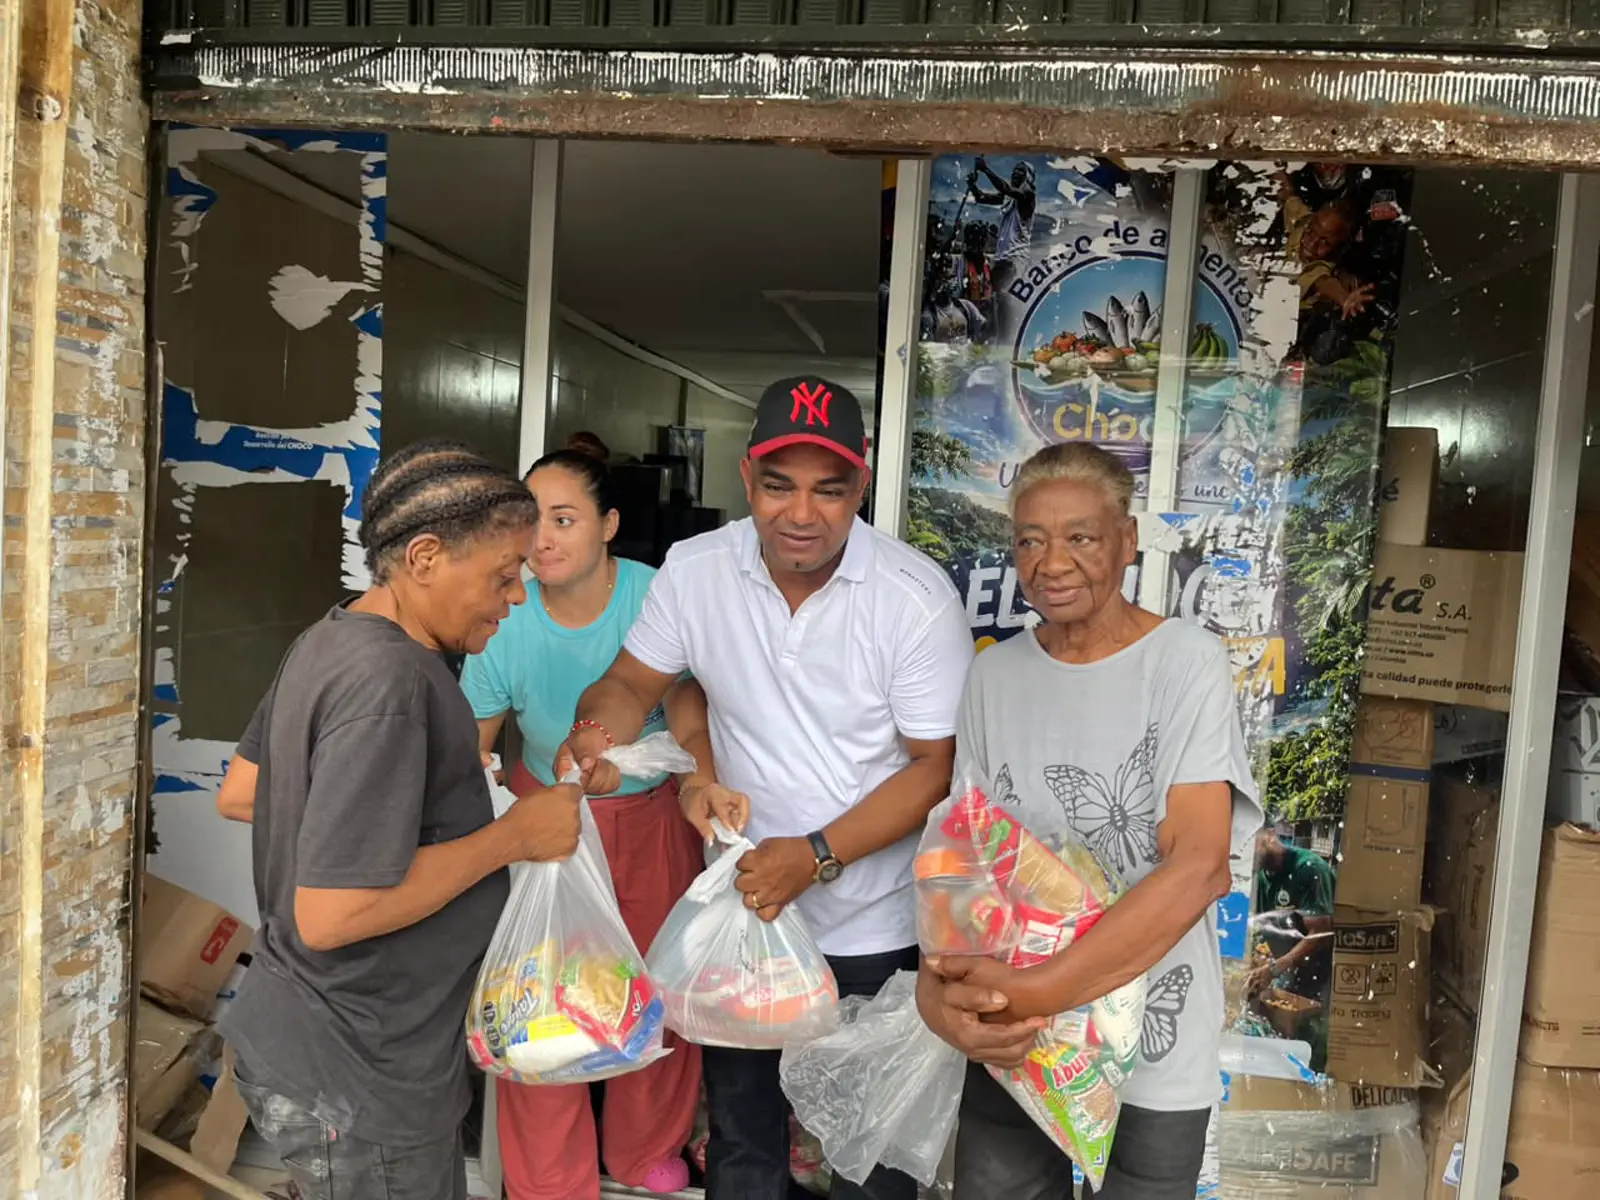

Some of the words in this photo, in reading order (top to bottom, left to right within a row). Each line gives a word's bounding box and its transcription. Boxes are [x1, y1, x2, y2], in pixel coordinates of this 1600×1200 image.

[790, 381, 833, 428] NY
[1436, 602, 1472, 620] S.A.
[1376, 671, 1416, 684] calidad
[1418, 676, 1453, 688] puede
